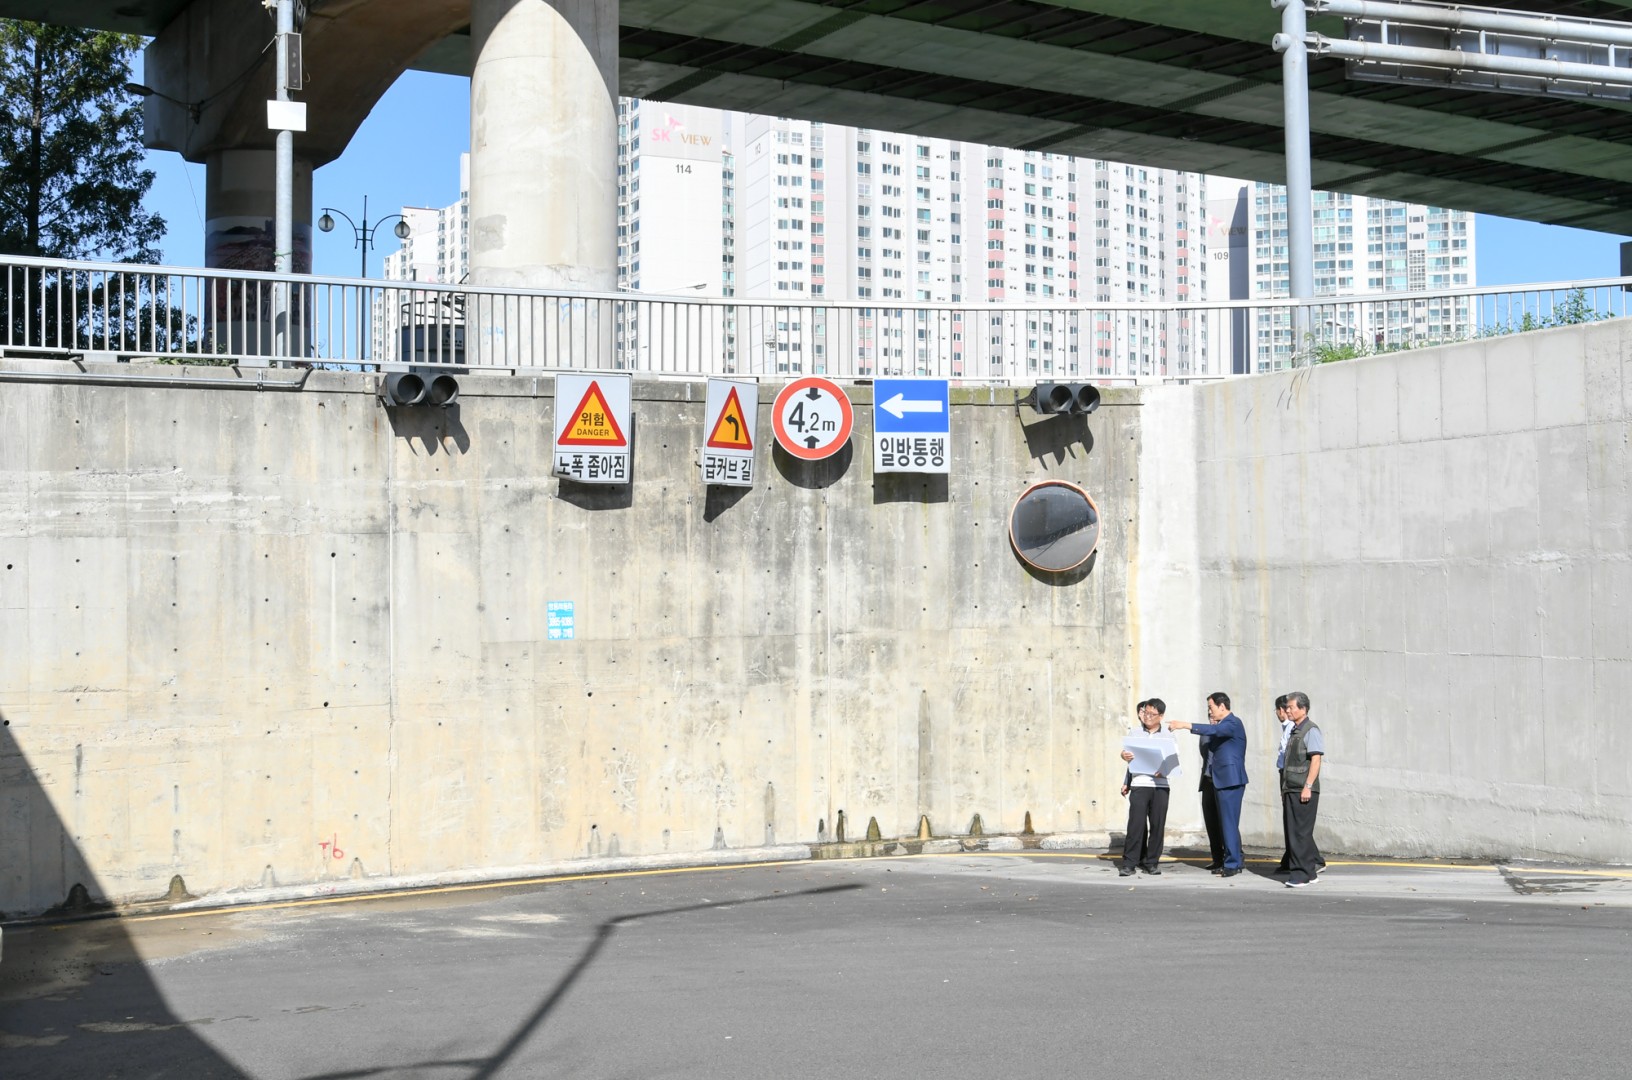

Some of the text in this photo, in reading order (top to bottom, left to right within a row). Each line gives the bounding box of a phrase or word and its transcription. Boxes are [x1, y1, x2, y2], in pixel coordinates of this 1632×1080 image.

[652, 128, 671, 142] SK
[681, 133, 712, 146] VIEW
[675, 164, 692, 174] 114
[1213, 252, 1229, 260] 109
[580, 412, 605, 427] 위험
[577, 428, 609, 436] DANGER
[879, 437, 945, 467] 일방통행
[557, 455, 626, 479] 노폭 좁아짐
